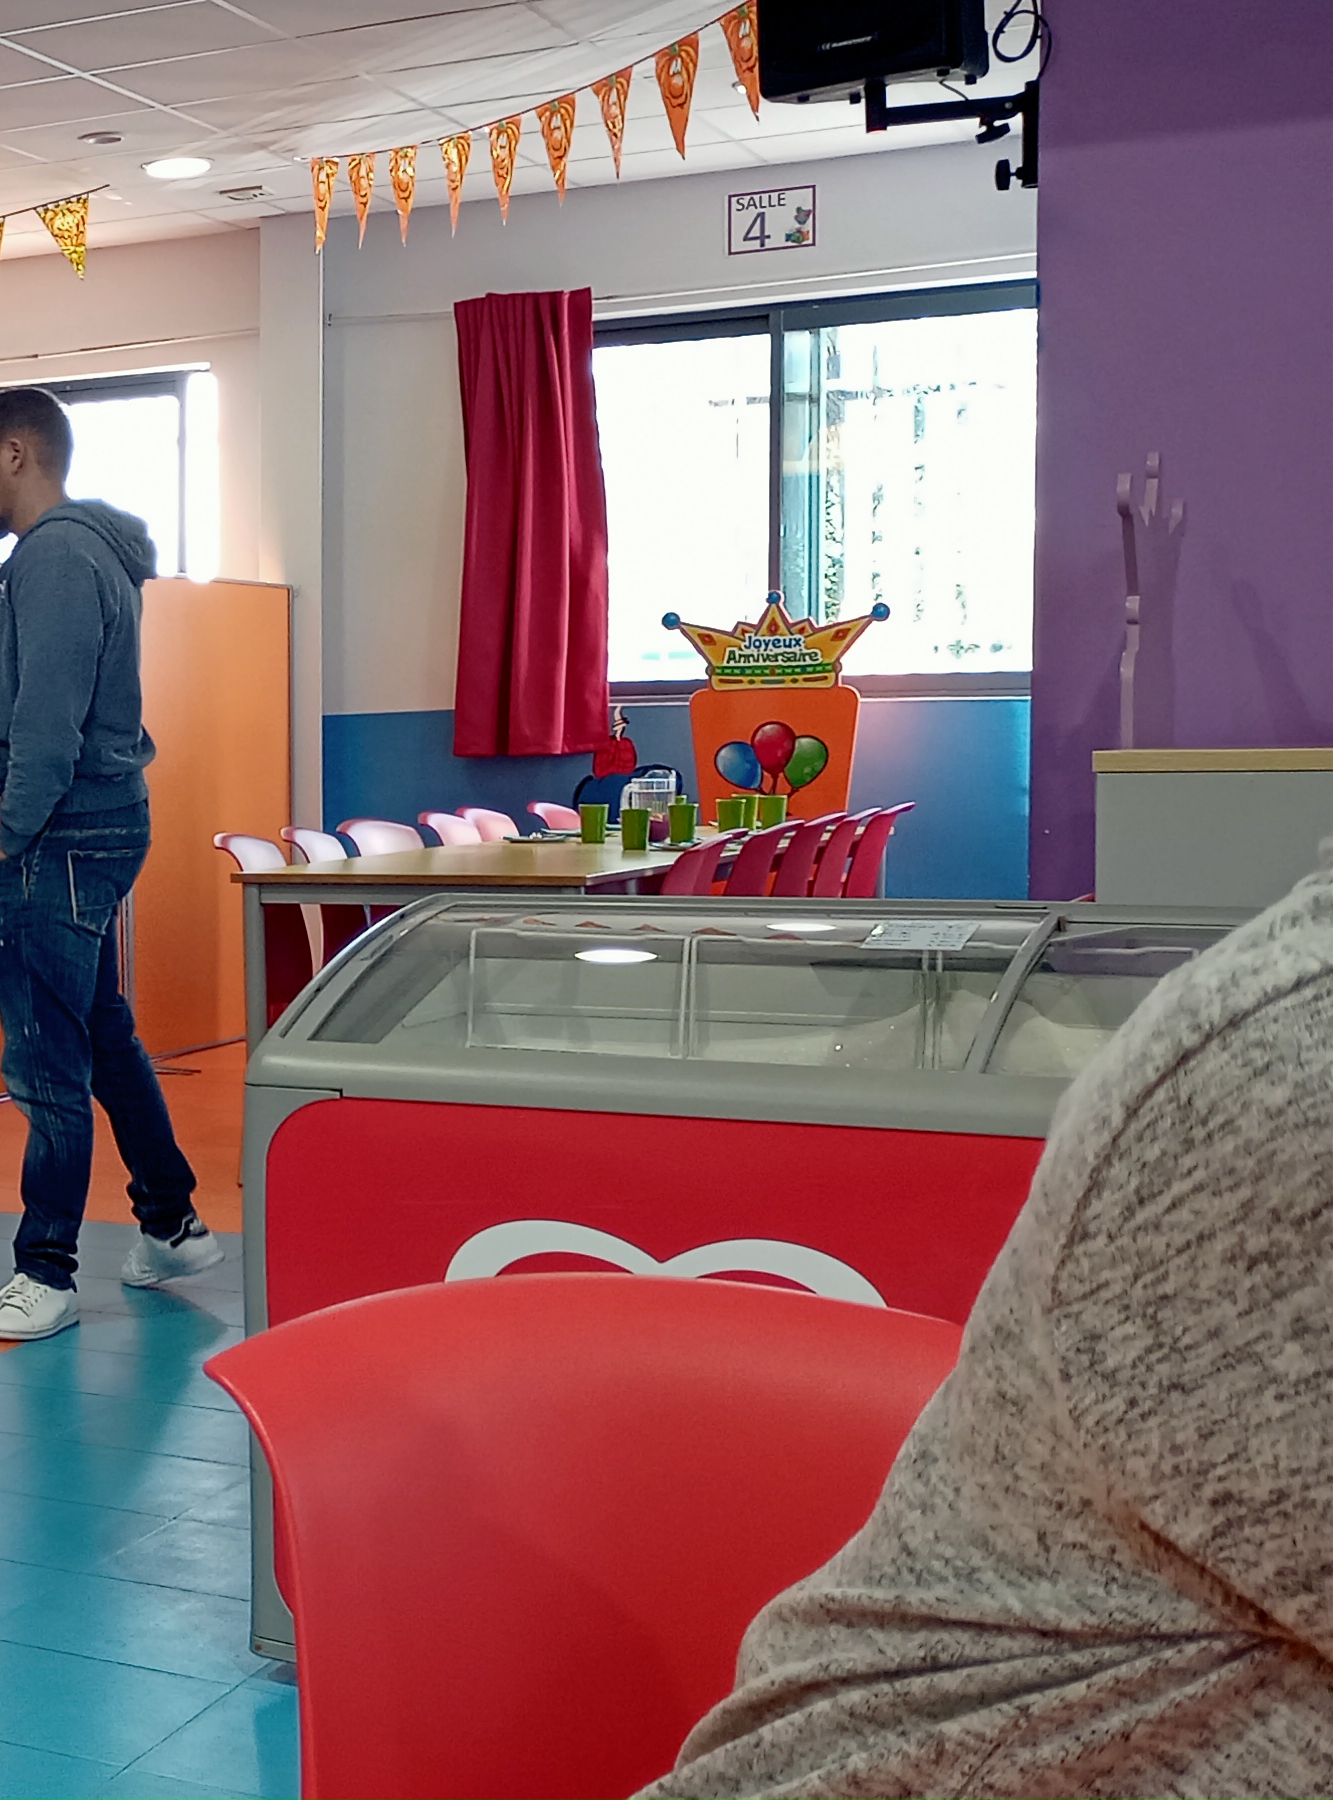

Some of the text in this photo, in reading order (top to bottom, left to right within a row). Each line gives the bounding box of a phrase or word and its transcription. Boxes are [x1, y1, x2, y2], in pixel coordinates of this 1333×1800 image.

[735, 192, 786, 212] SALLE
[742, 211, 771, 248] 4
[744, 635, 803, 652] Joyeux
[726, 649, 820, 665] Anniversaire
